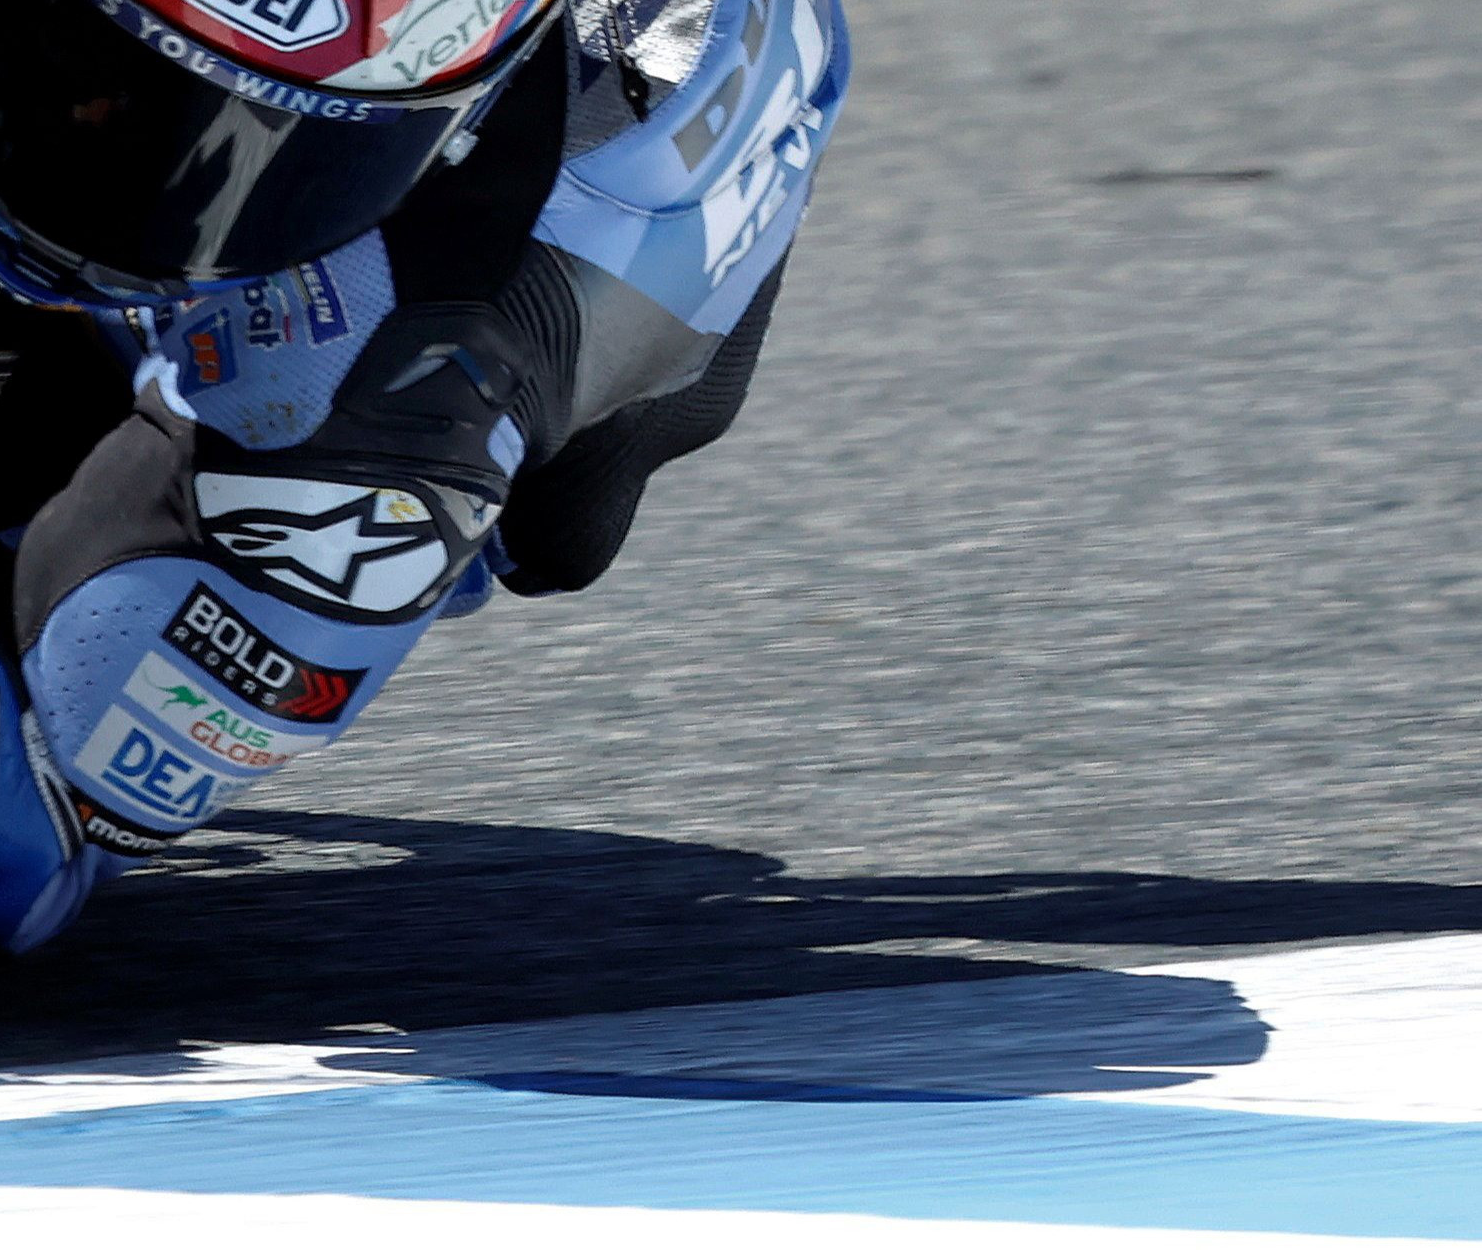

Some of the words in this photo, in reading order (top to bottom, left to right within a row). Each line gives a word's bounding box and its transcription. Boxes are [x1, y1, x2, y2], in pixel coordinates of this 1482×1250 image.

[139, 13, 213, 75] YOU
[237, 73, 372, 124] WINGS
[173, 626, 277, 707] RIDERS
[184, 594, 294, 689] BOLD
[109, 728, 216, 818] DEA
[205, 709, 273, 748] AUS
